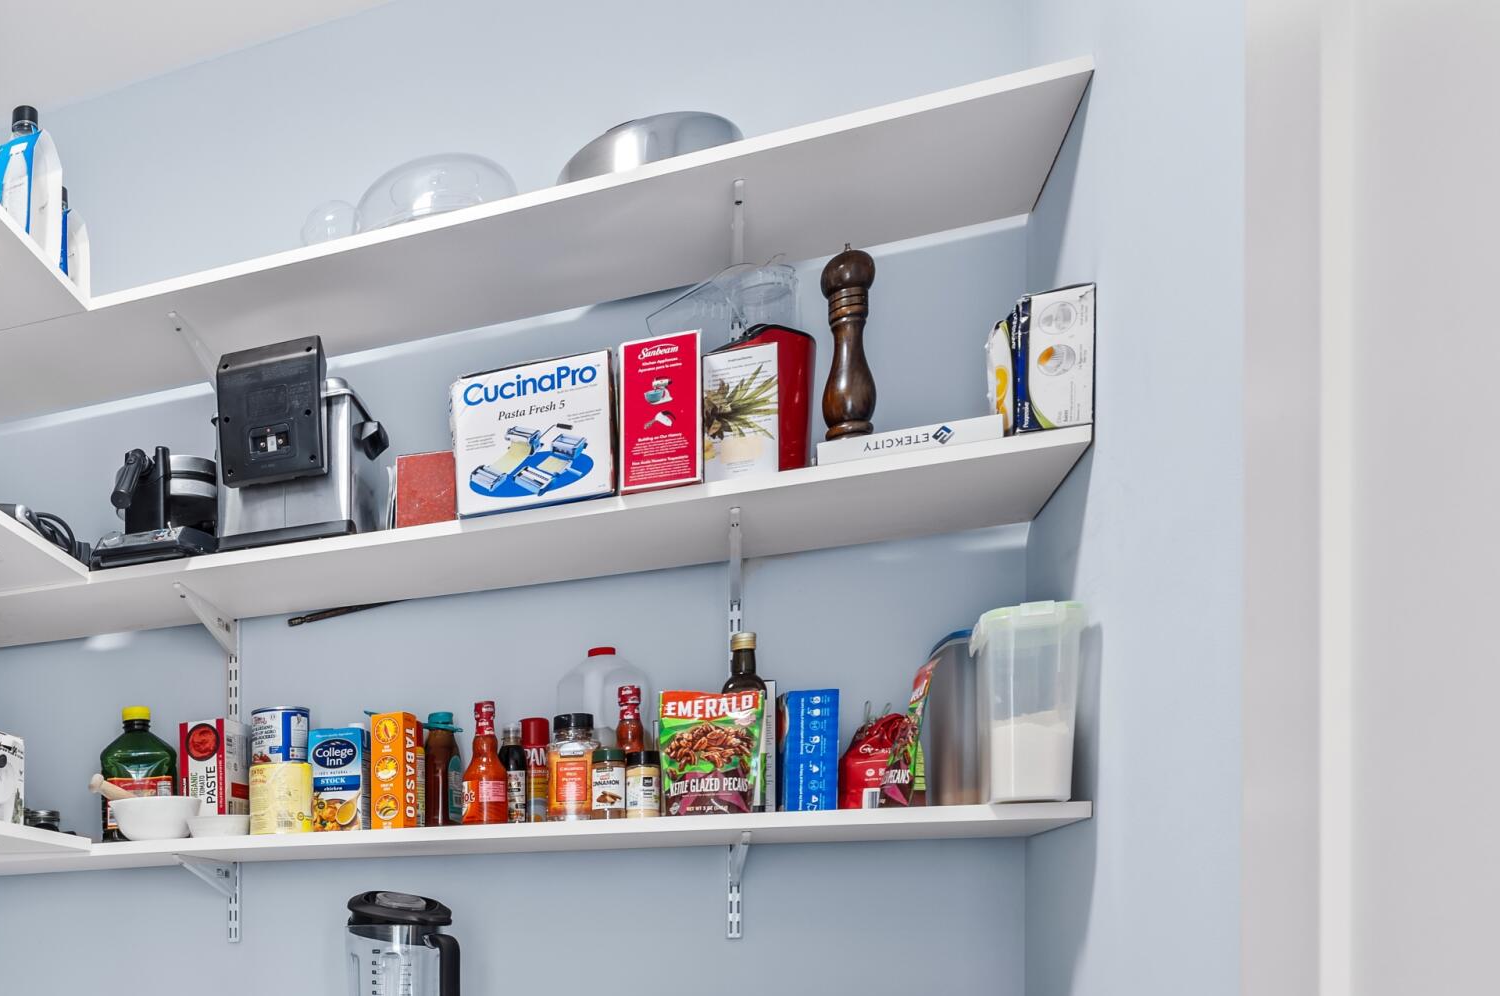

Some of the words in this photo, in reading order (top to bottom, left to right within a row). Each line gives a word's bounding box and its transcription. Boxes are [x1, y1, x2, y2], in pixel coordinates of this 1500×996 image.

[637, 345, 679, 360] Sunbeam
[657, 357, 679, 365] Appliances
[463, 365, 597, 406] CucinaPro
[498, 408, 526, 421] Pasta
[529, 401, 557, 416] Fresh
[559, 399, 566, 410] 5
[863, 433, 930, 452] ETEKCITY
[665, 694, 754, 718] EMERALD
[315, 747, 354, 759] College
[326, 757, 343, 766] Inn
[524, 748, 547, 766] PAM
[320, 777, 346, 785] STOCK
[405, 727, 416, 818] TABASCO
[191, 772, 199, 798] RGANIC
[205, 765, 216, 804] PASTE
[670, 779, 689, 797] KETTLE
[690, 777, 720, 793] GLAZED
[723, 776, 748, 791] PECANS
